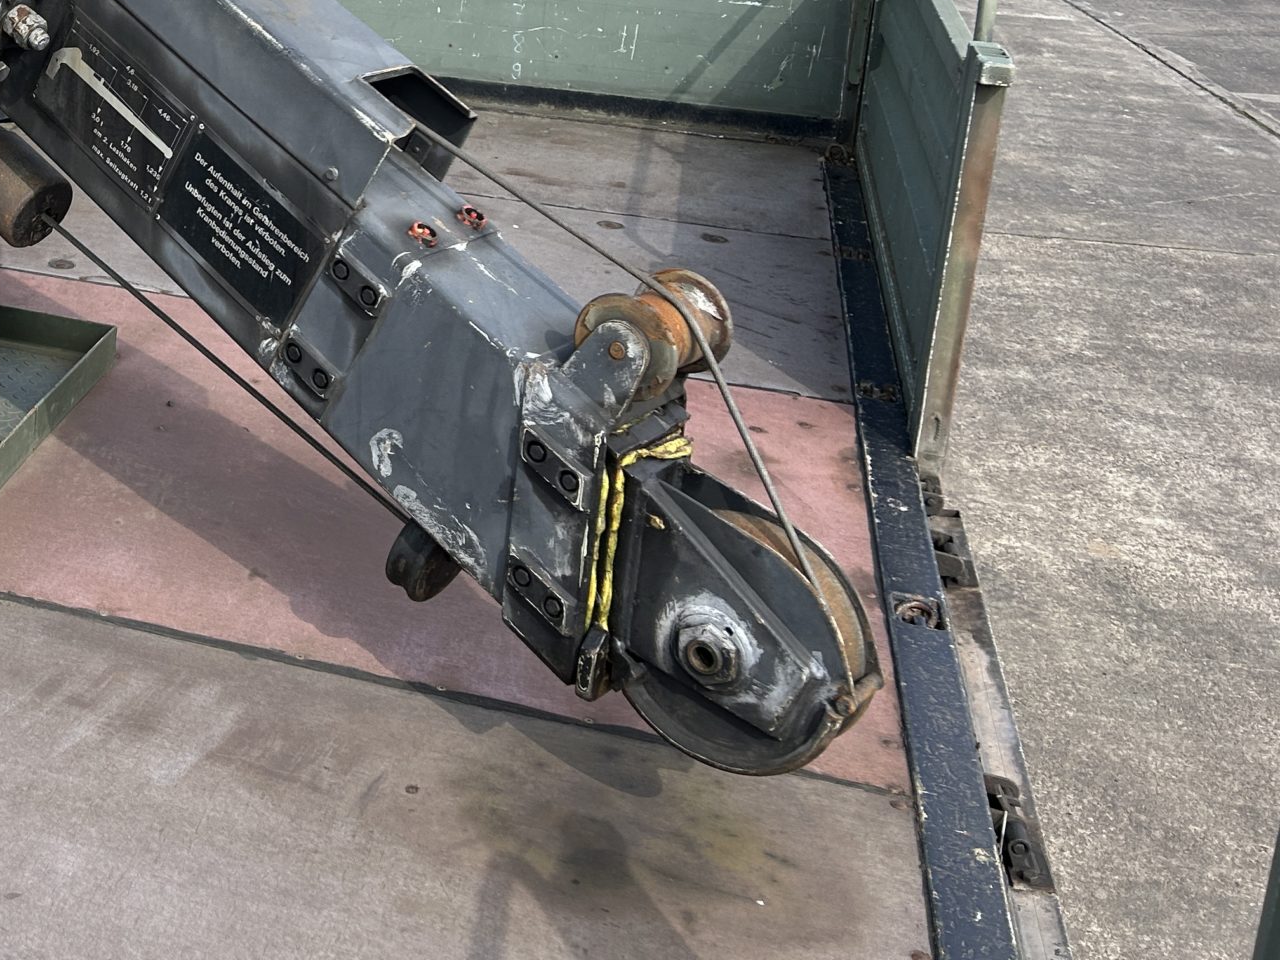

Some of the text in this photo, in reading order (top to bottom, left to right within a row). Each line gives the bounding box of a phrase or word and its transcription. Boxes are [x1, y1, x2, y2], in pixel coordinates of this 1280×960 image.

[105, 157, 139, 191] Seilzugkraft
[109, 142, 138, 172] Lasthaken
[184, 181, 292, 286] Unbefugten ist der Aufstieg zum
[194, 152, 310, 263] Der Aufenthalt im Gefahrenbereich
[196, 206, 269, 279] Kranbedienungsstand
[205, 178, 286, 257] des Kranes ist verboten.
[210, 236, 242, 269] verboten.
